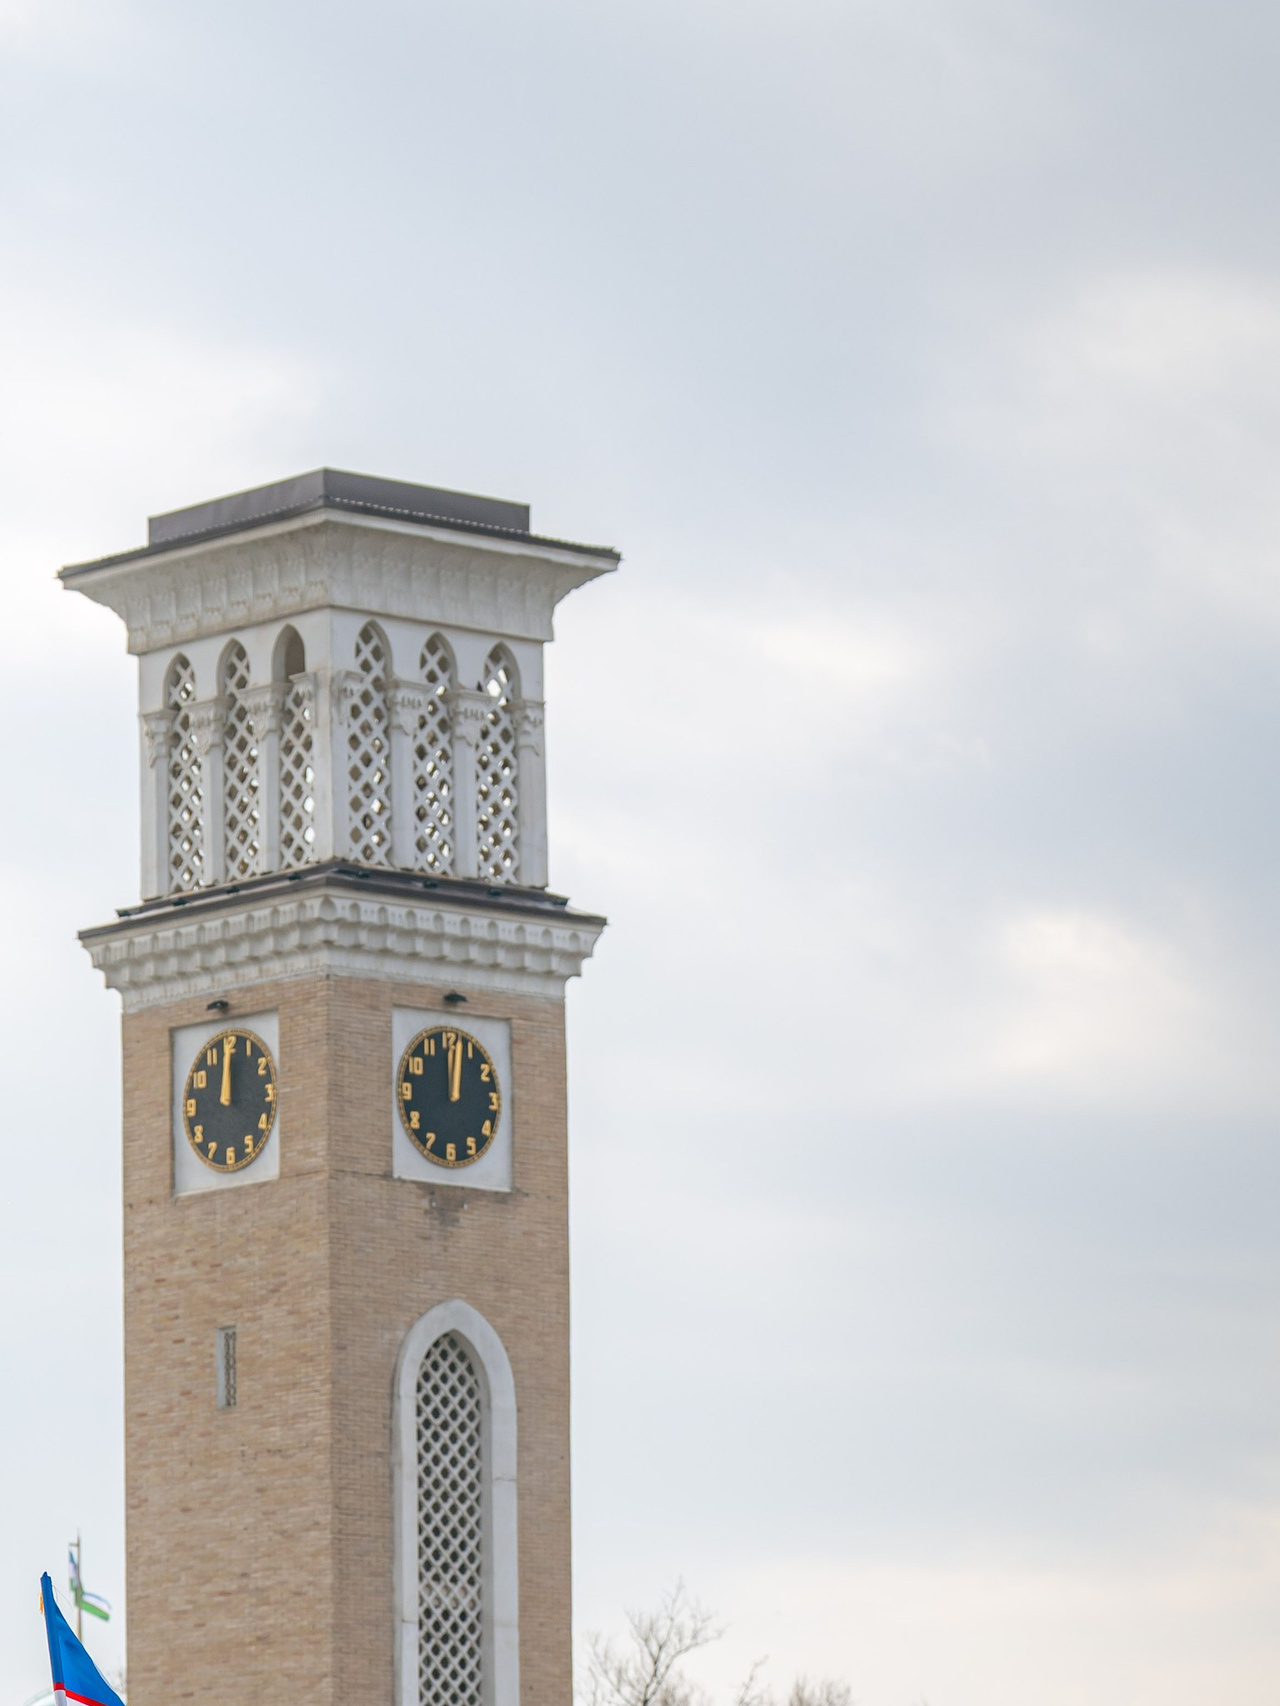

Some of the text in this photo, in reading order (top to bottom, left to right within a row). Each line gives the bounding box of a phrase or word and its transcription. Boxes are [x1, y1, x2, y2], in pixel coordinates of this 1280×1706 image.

[246, 1039, 252, 1057] 1
[424, 1038, 435, 1056] 11
[467, 1041, 473, 1059] 1
[207, 1048, 218, 1066] 11
[257, 1057, 267, 1076] 2
[408, 1057, 424, 1076] 10
[193, 1070, 207, 1089] 10
[480, 1063, 491, 1082] 2
[264, 1083, 275, 1102] 3
[402, 1082, 412, 1101] 9
[186, 1098, 196, 1117] 9
[488, 1092, 499, 1111] 3
[258, 1112, 267, 1130] 4
[410, 1110, 420, 1129] 8
[481, 1119, 491, 1137] 4
[194, 1124, 204, 1143] 8
[425, 1132, 436, 1150] 7
[207, 1141, 218, 1160] 7
[244, 1134, 254, 1154] 5
[446, 1143, 456, 1161] 6
[466, 1136, 476, 1155] 5
[226, 1146, 236, 1165] 6
